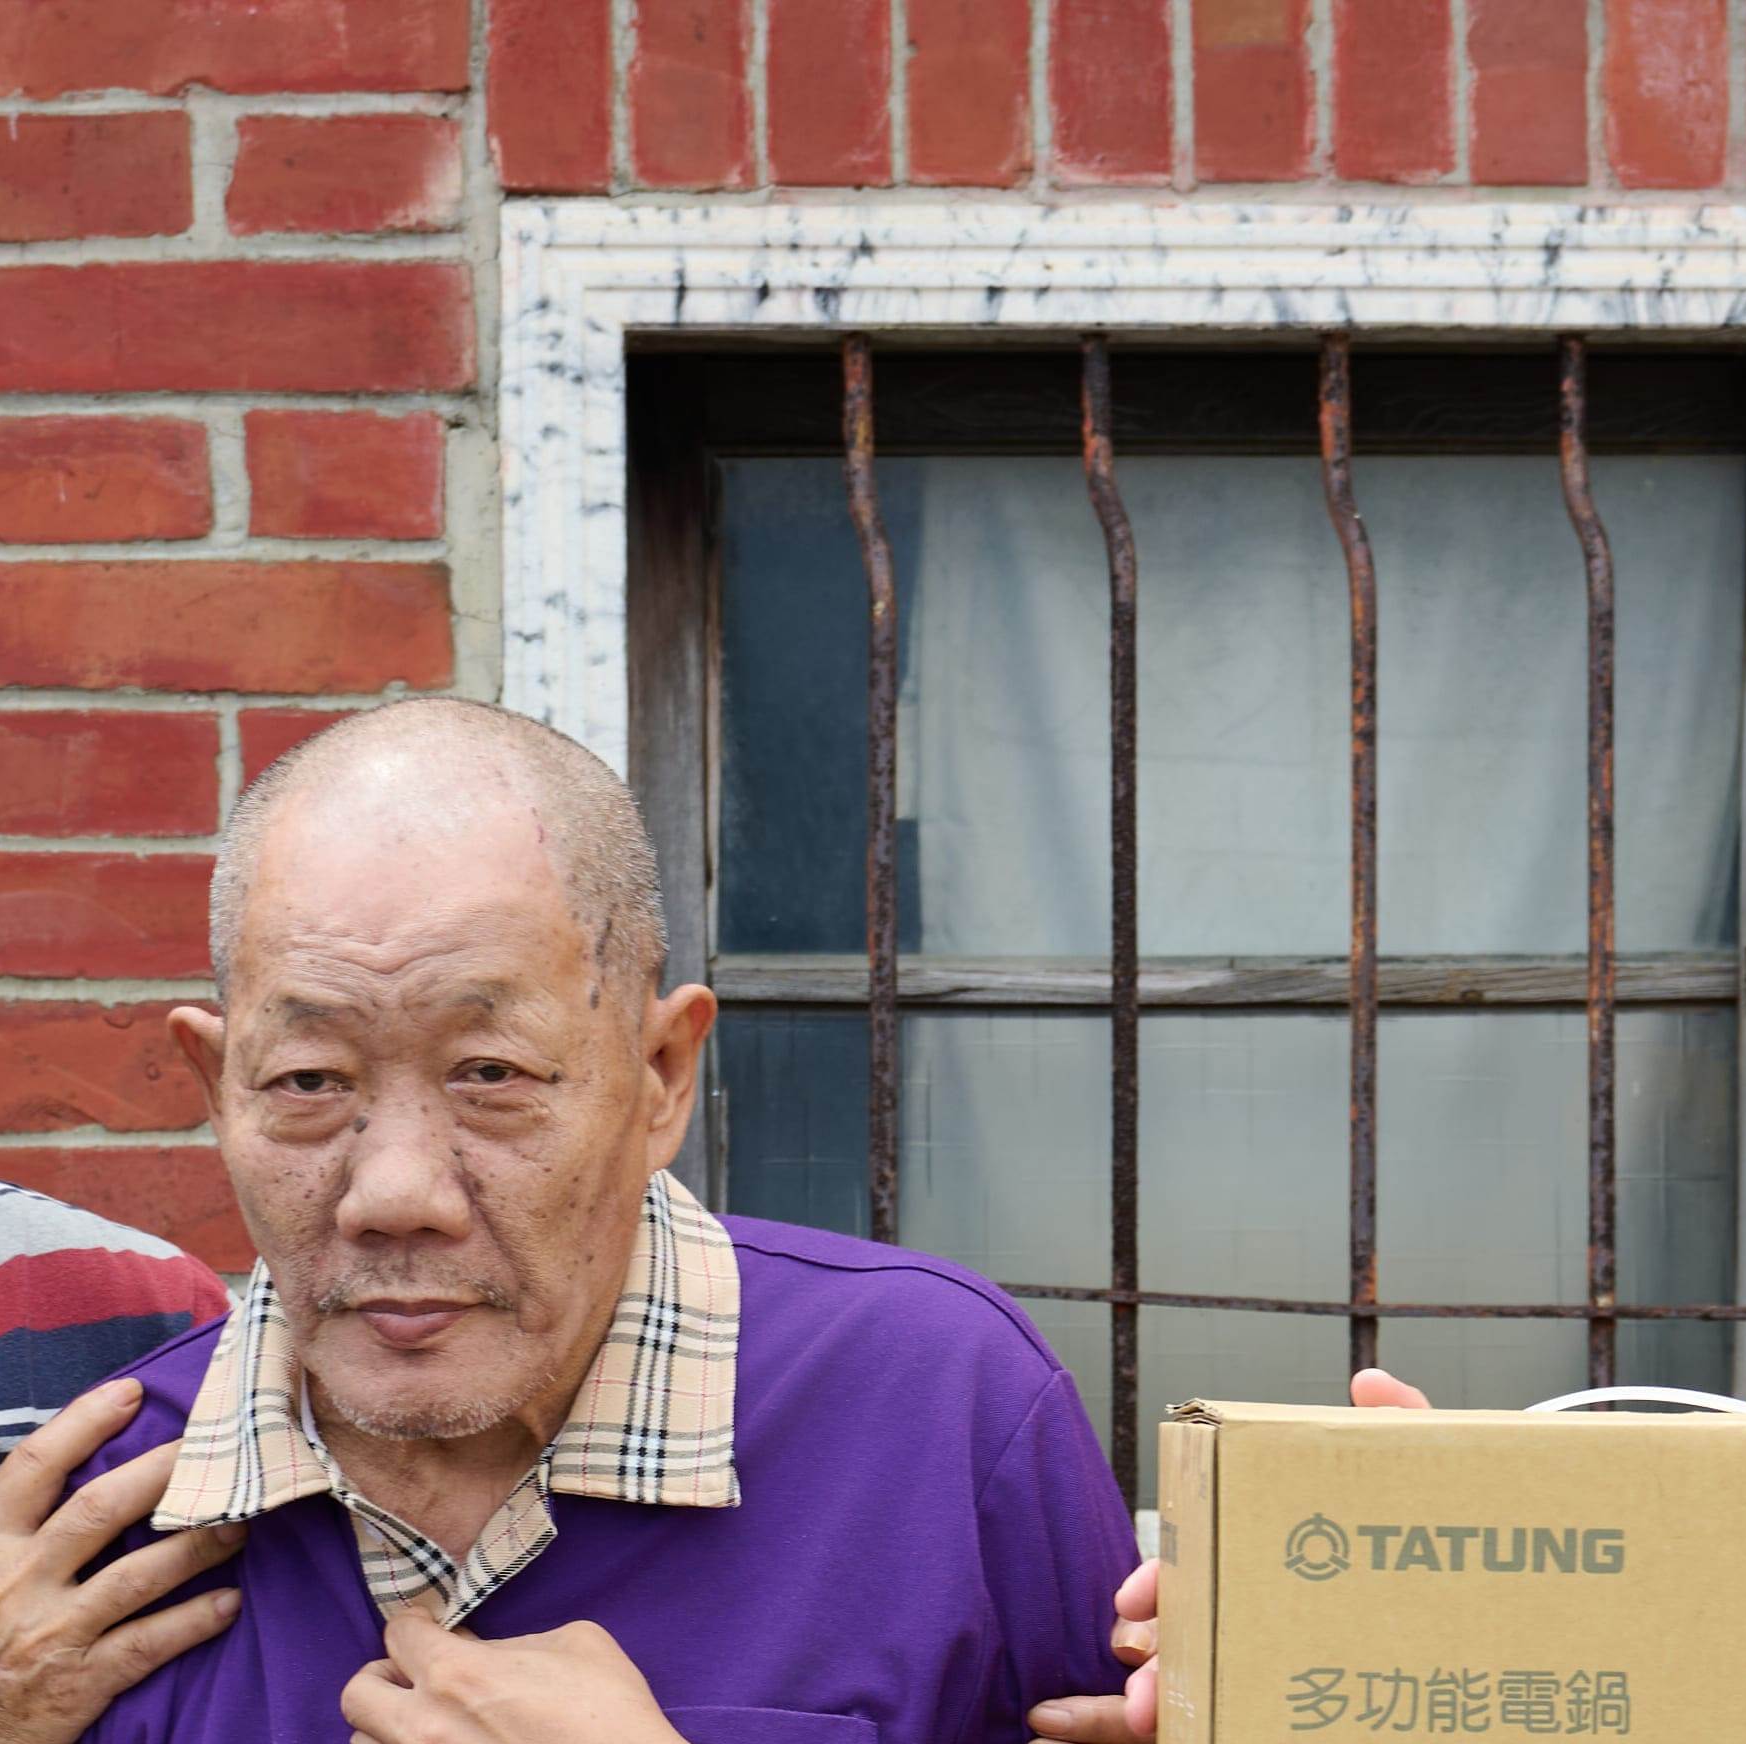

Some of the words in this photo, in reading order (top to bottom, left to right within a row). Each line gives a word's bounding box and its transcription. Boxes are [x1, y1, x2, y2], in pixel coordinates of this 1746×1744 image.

[1357, 1525, 1626, 1574] TATUNG
[1285, 1667, 1631, 1735] 多功能電鍋
